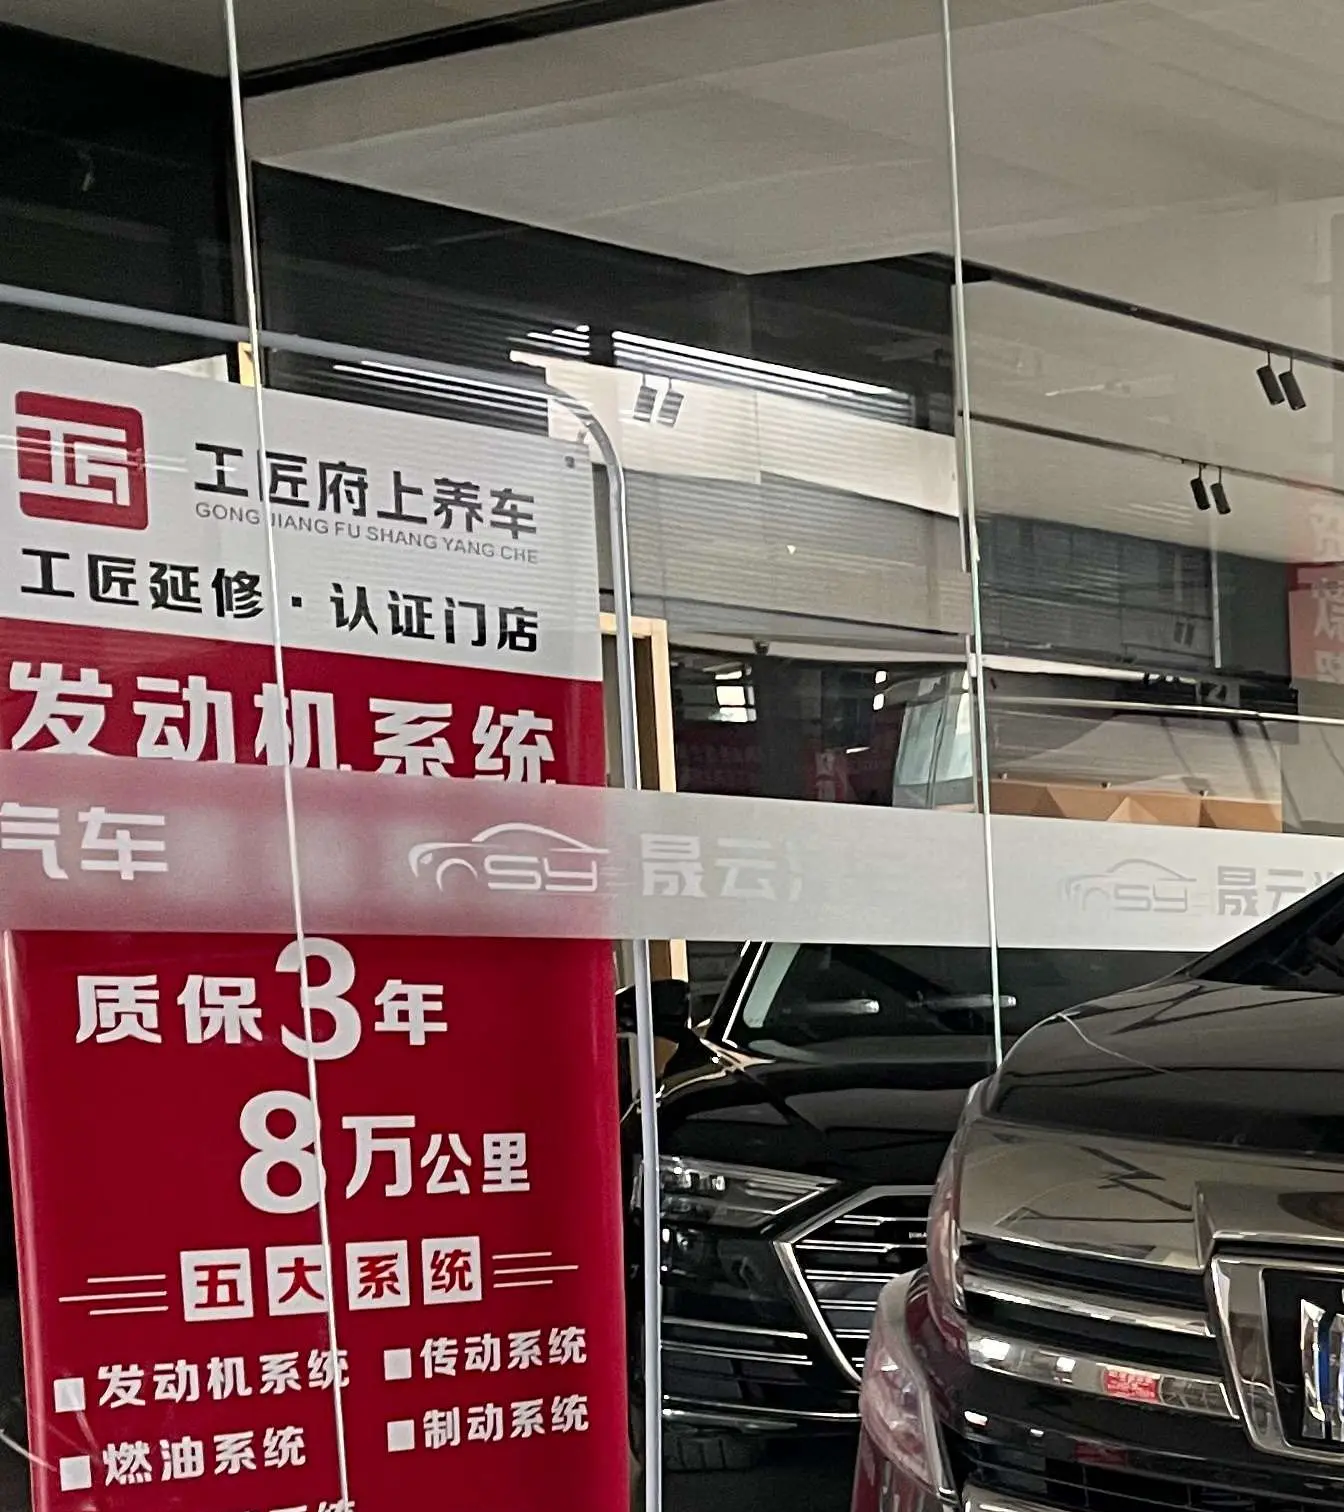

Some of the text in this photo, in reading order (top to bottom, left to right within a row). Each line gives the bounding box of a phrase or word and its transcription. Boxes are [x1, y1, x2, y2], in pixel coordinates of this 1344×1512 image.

[194, 442, 537, 539] 工匠府上养车
[195, 502, 260, 525] GONG
[335, 521, 361, 539] FU
[365, 527, 437, 550] SHANG
[442, 537, 495, 558] YANG
[500, 545, 540, 565] CHE
[9, 661, 557, 783] 发动机系统
[641, 833, 802, 901] 晟云
[187, 1243, 478, 1315] 五大系统
[97, 1348, 350, 1408] 发动机系统
[420, 1326, 588, 1380] 传动系统
[423, 1394, 590, 1450] 制动系统
[103, 1426, 306, 1487] 燃油系统
